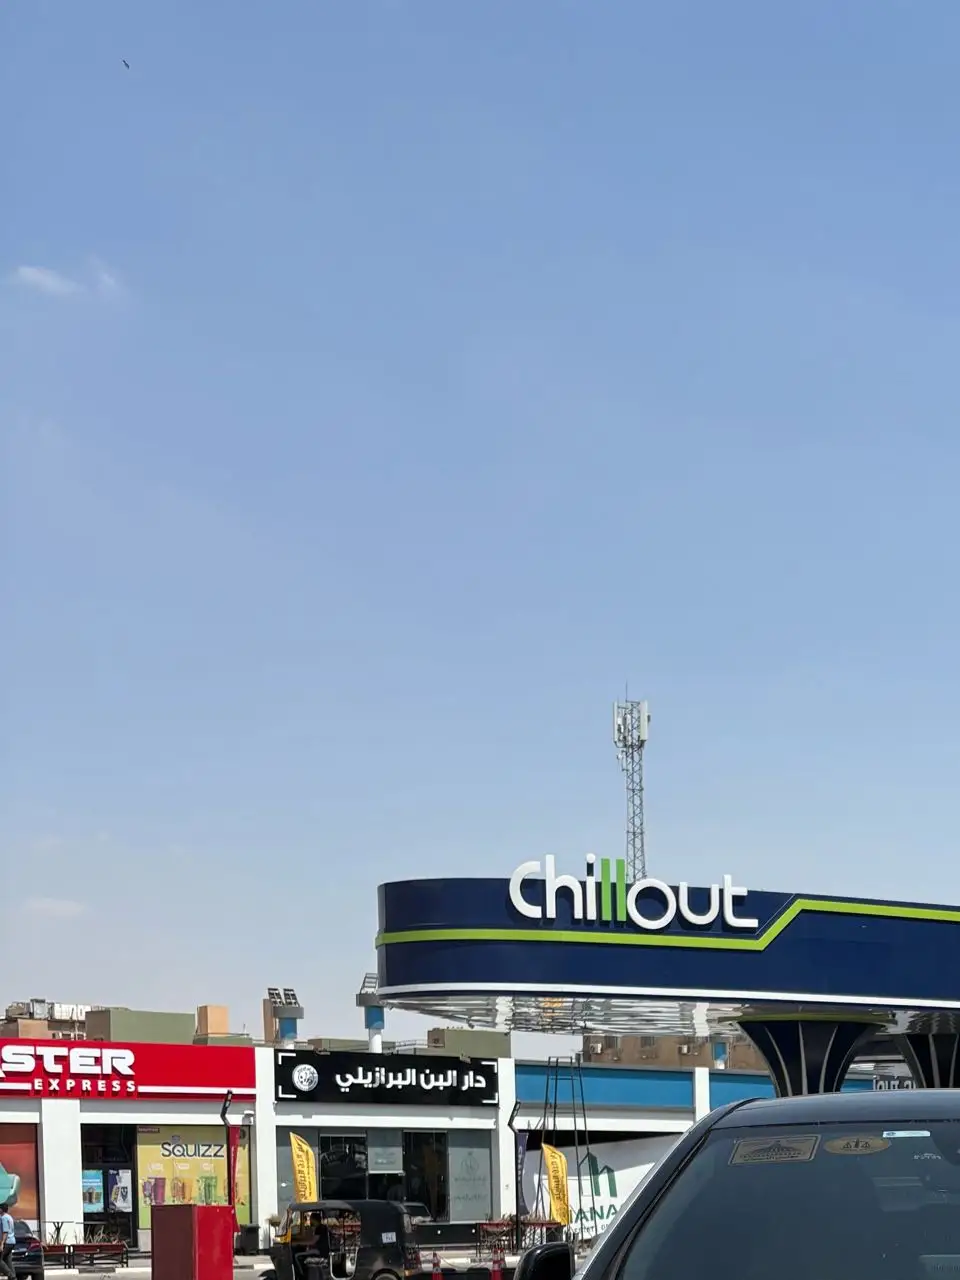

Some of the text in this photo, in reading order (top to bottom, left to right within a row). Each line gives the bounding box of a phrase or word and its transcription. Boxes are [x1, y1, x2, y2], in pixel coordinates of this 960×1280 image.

[0, 1044, 136, 1078] STER
[33, 1078, 136, 1093] EXPRESS
[335, 1066, 487, 1093] دار البن البرازيلي
